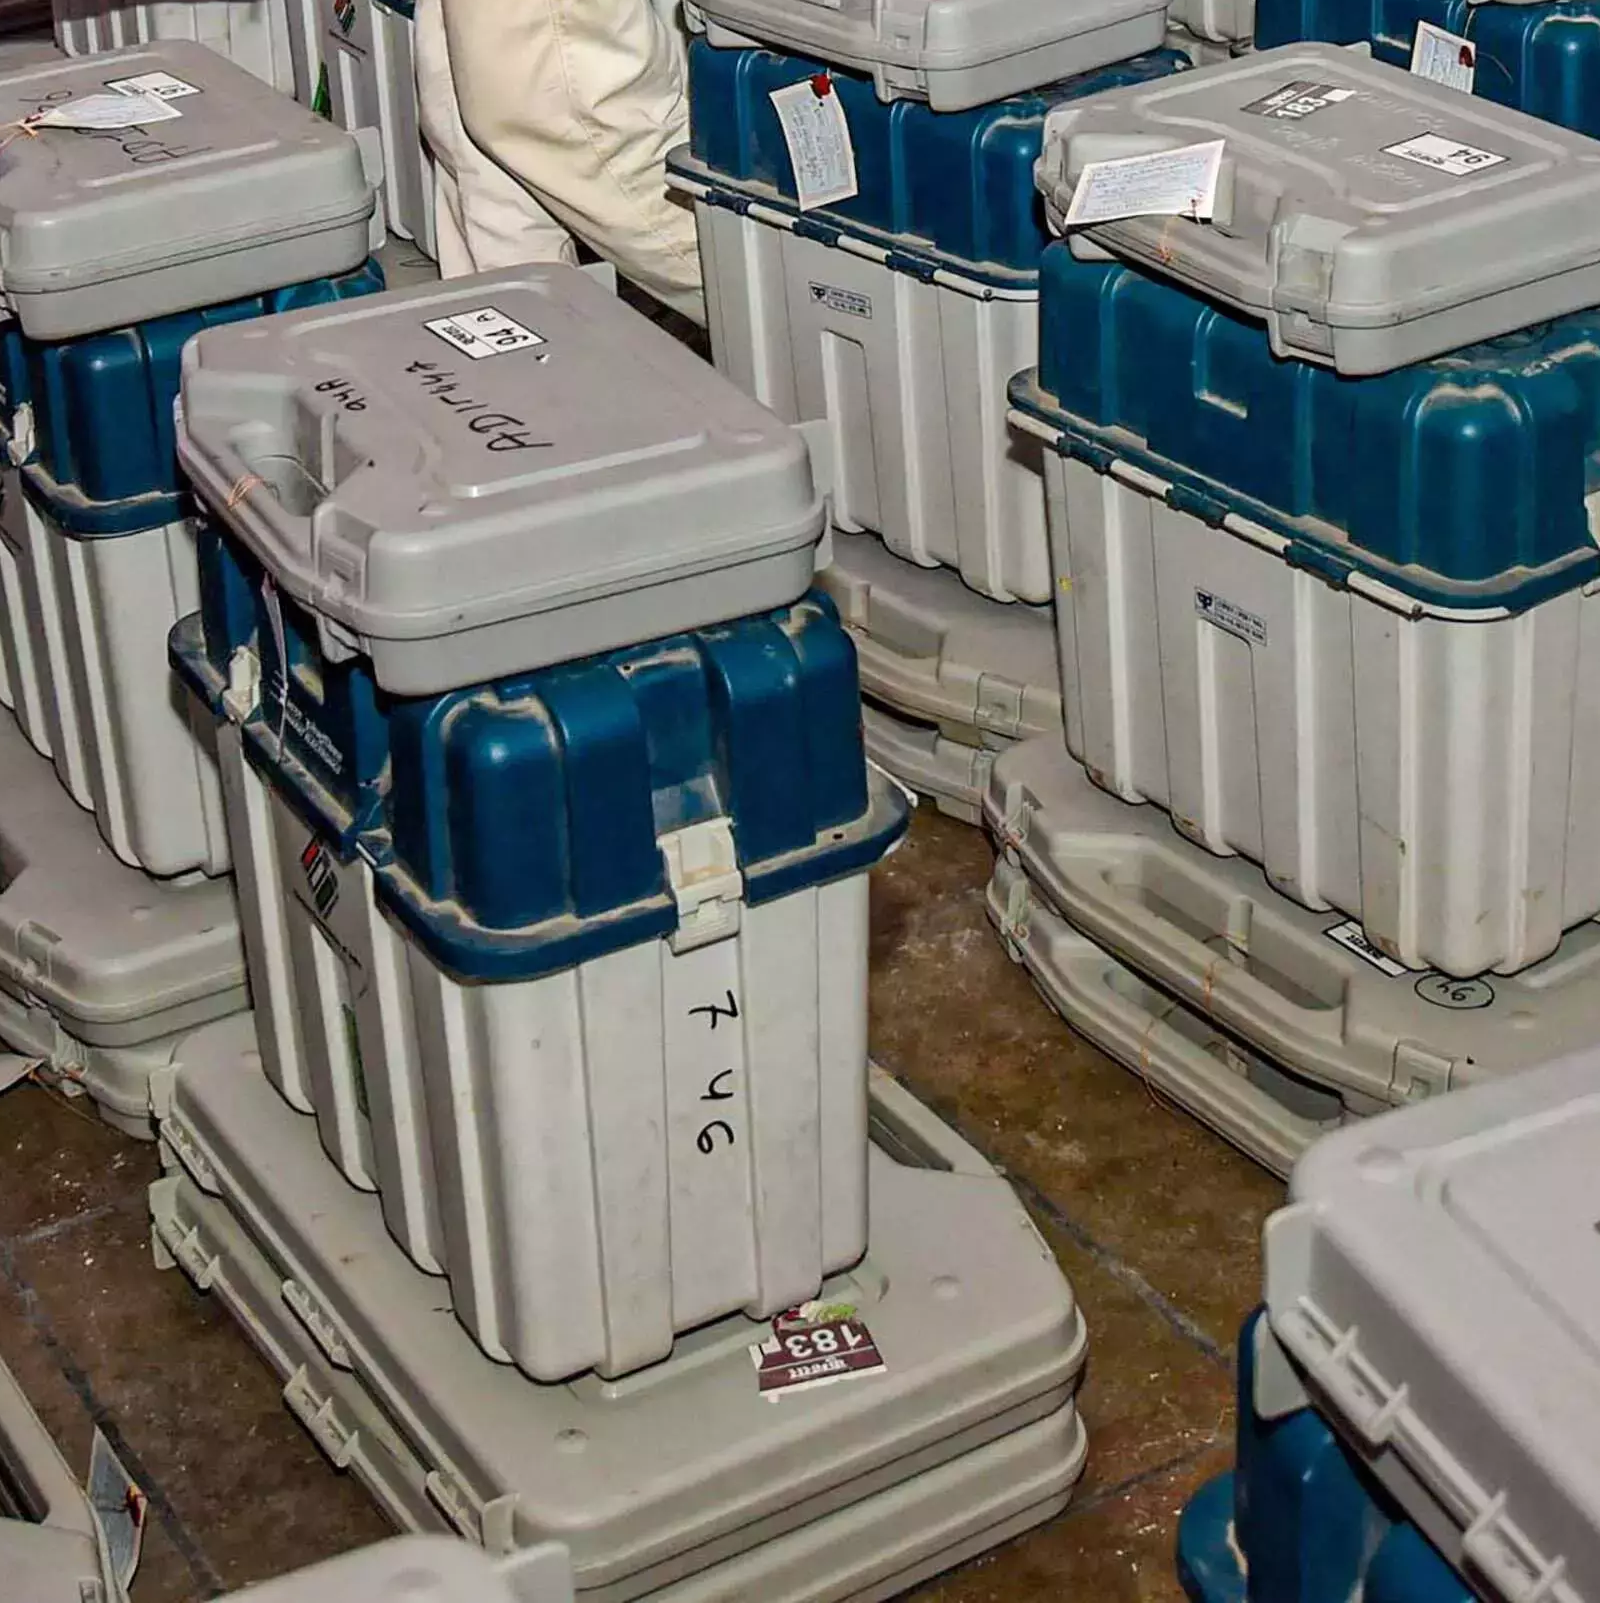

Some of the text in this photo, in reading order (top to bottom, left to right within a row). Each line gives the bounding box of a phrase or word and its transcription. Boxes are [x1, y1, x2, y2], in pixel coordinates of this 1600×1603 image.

[1276, 96, 1329, 122] 183
[1448, 148, 1491, 167] 94
[782, 1320, 865, 1360] 183
